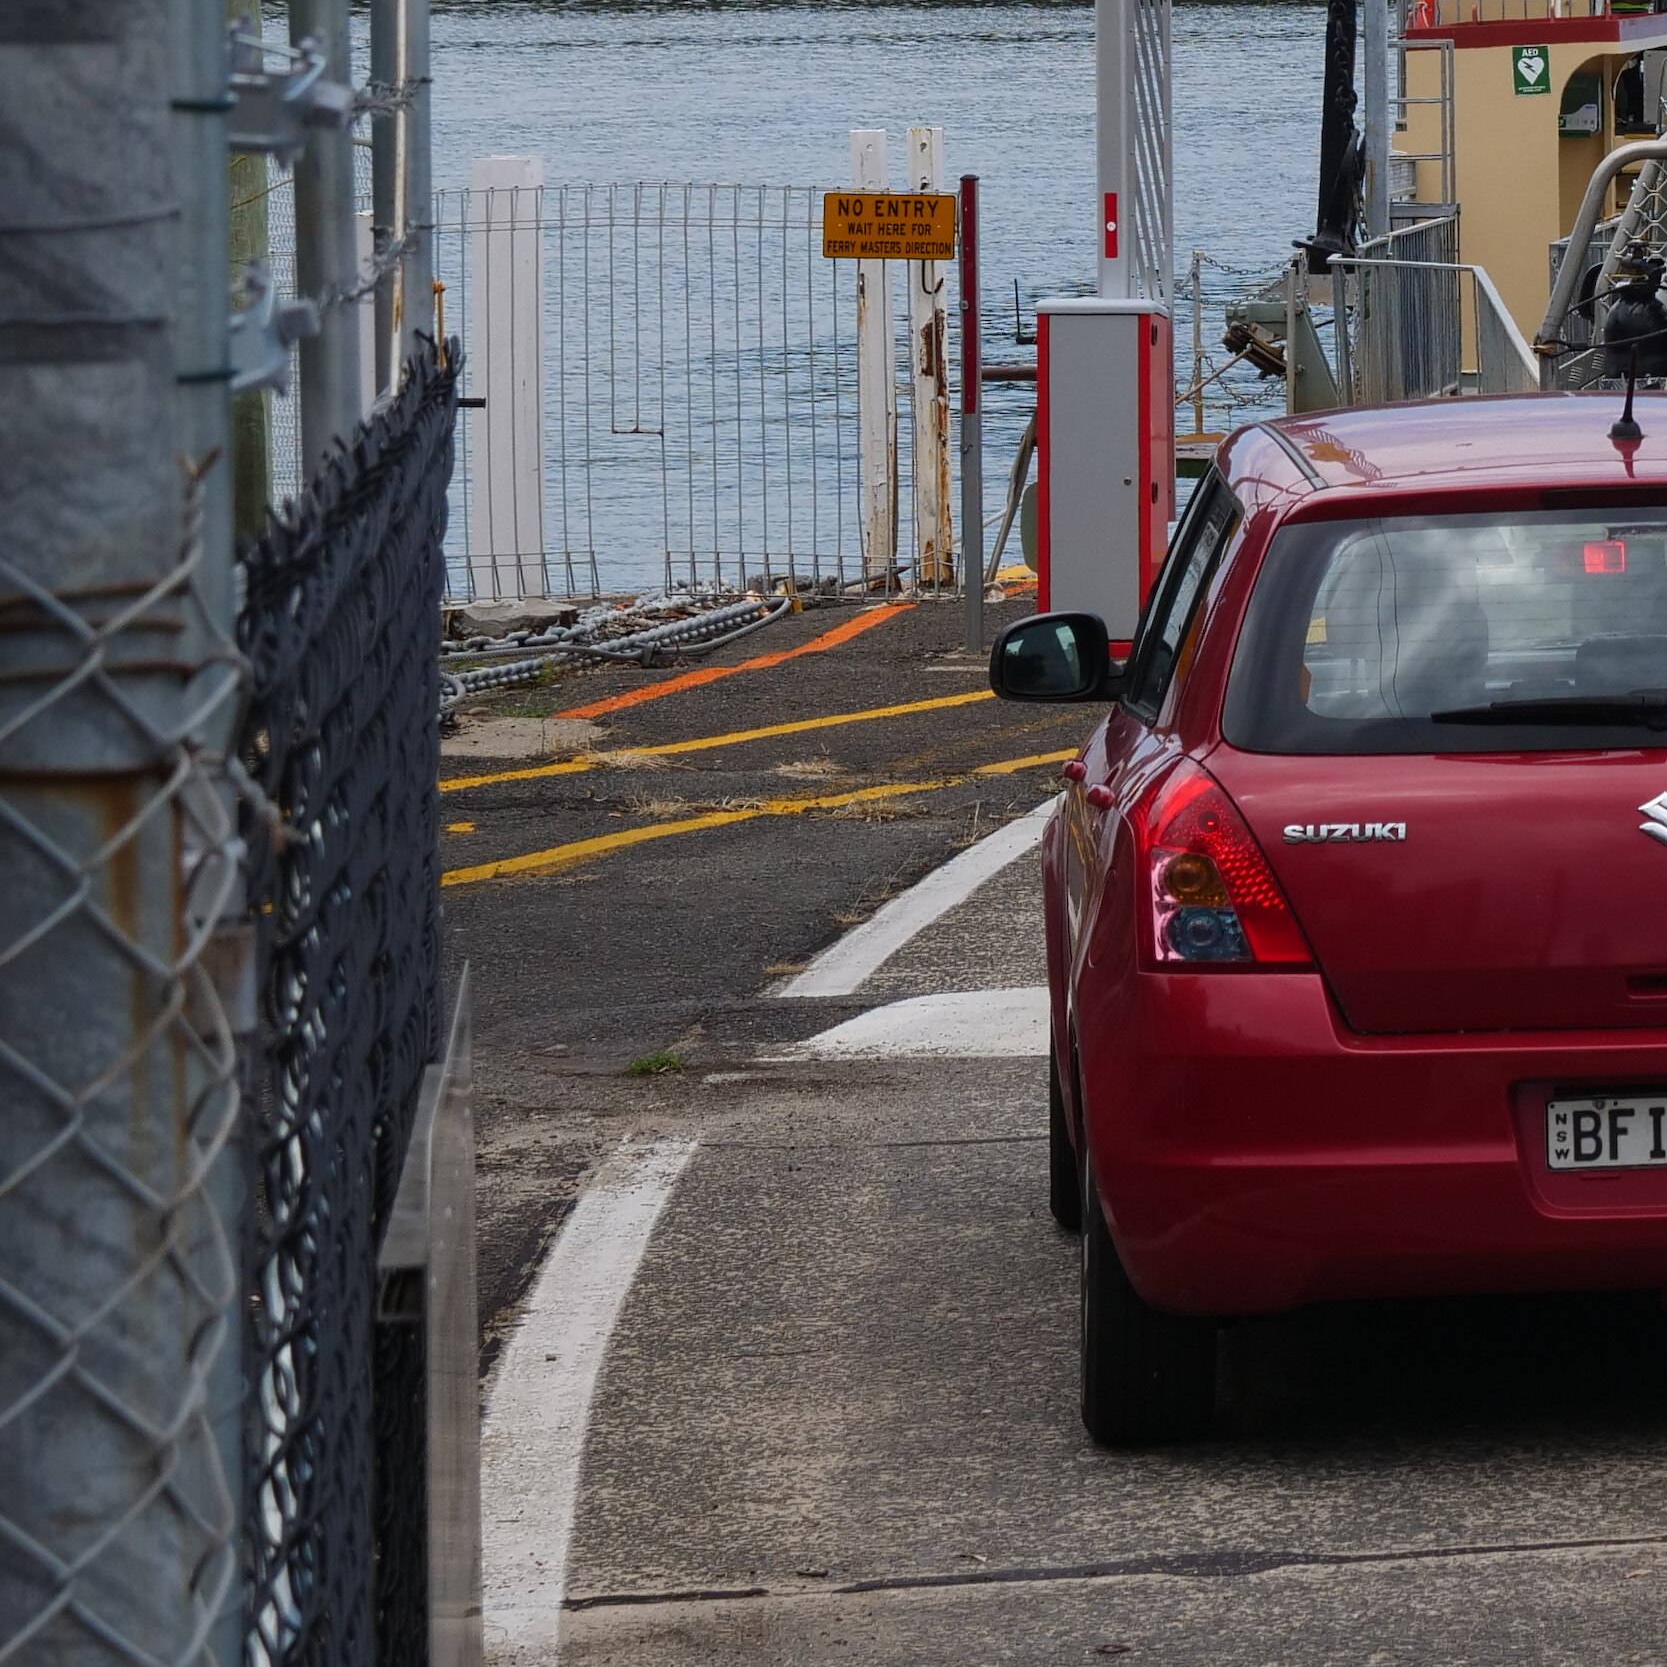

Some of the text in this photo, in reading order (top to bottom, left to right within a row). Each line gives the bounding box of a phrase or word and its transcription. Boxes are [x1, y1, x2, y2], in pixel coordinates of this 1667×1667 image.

[1521, 48, 1539, 58] AED
[838, 199, 938, 217] NO ENTRY
[848, 223, 931, 236] WAIT HERE FOR
[827, 241, 856, 253] FERRY
[905, 242, 951, 254] DIRECTION
[1283, 823, 1407, 844] SUZUKI
